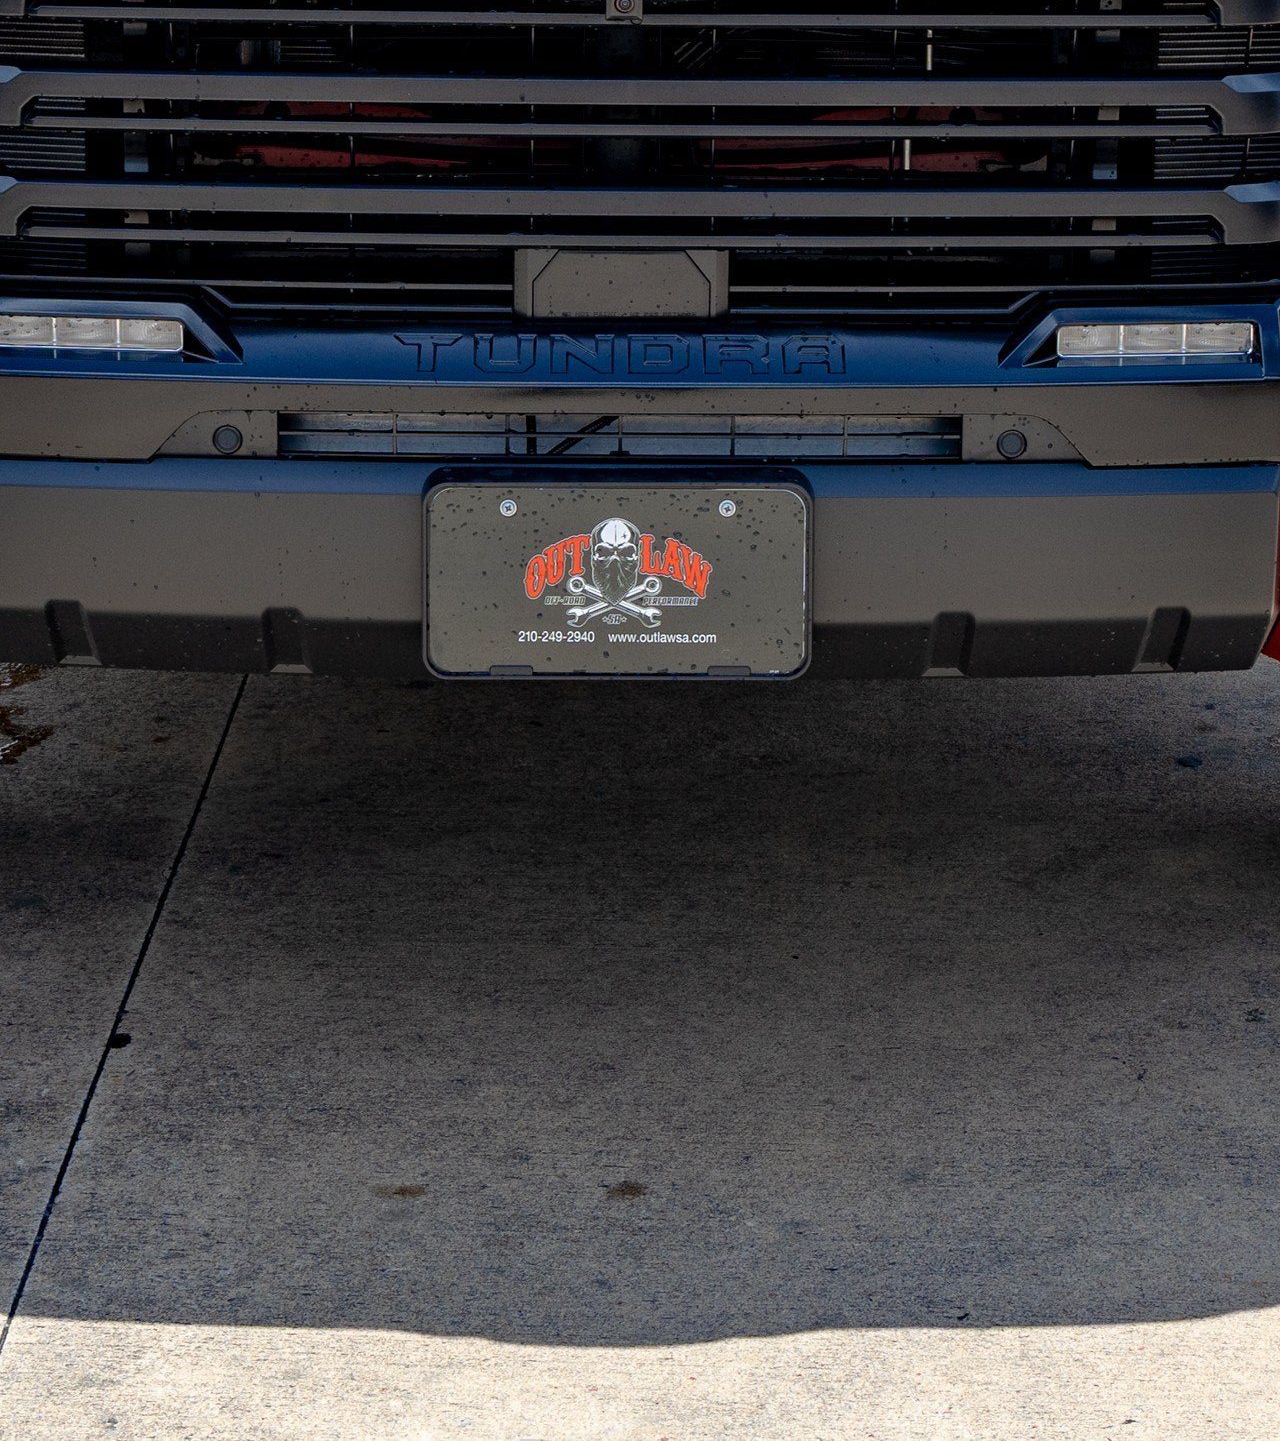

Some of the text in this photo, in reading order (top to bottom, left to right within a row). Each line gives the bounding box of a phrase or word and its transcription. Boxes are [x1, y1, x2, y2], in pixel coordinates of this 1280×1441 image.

[392, 333, 847, 375] TUNDRA
[642, 596, 699, 606] PERFORMANCE
[518, 631, 717, 645] 210-249-2940 www.outlawsa.com
